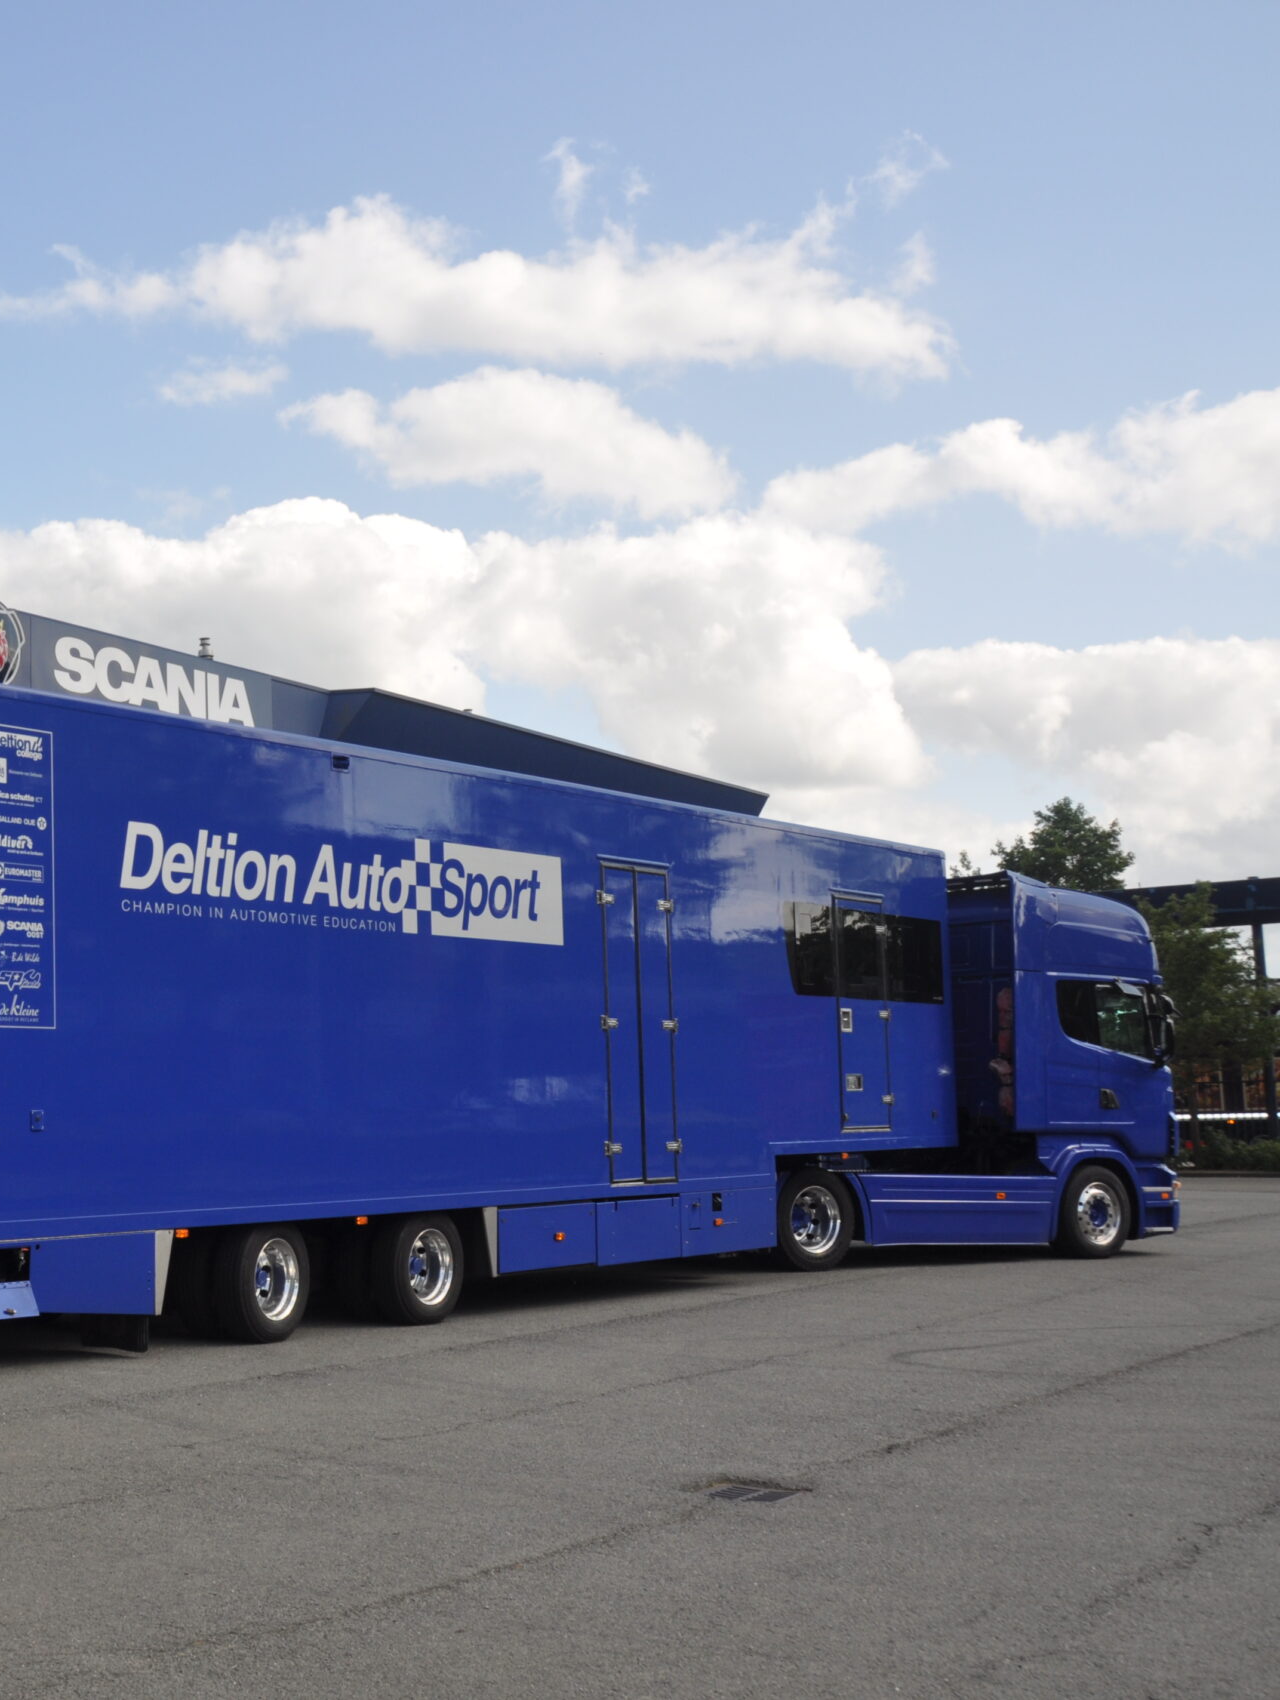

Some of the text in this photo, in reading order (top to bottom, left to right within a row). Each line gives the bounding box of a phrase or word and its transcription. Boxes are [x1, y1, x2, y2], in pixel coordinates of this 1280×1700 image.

[54, 636, 255, 728] SCANIA
[10, 793, 34, 802] schutte
[4, 867, 42, 878] EUROMASTER
[120, 821, 296, 902] Deltion
[6, 921, 44, 931] SCANIA
[121, 900, 396, 933] CHAMPION IN AUTOMOTIVE EDUCATION
